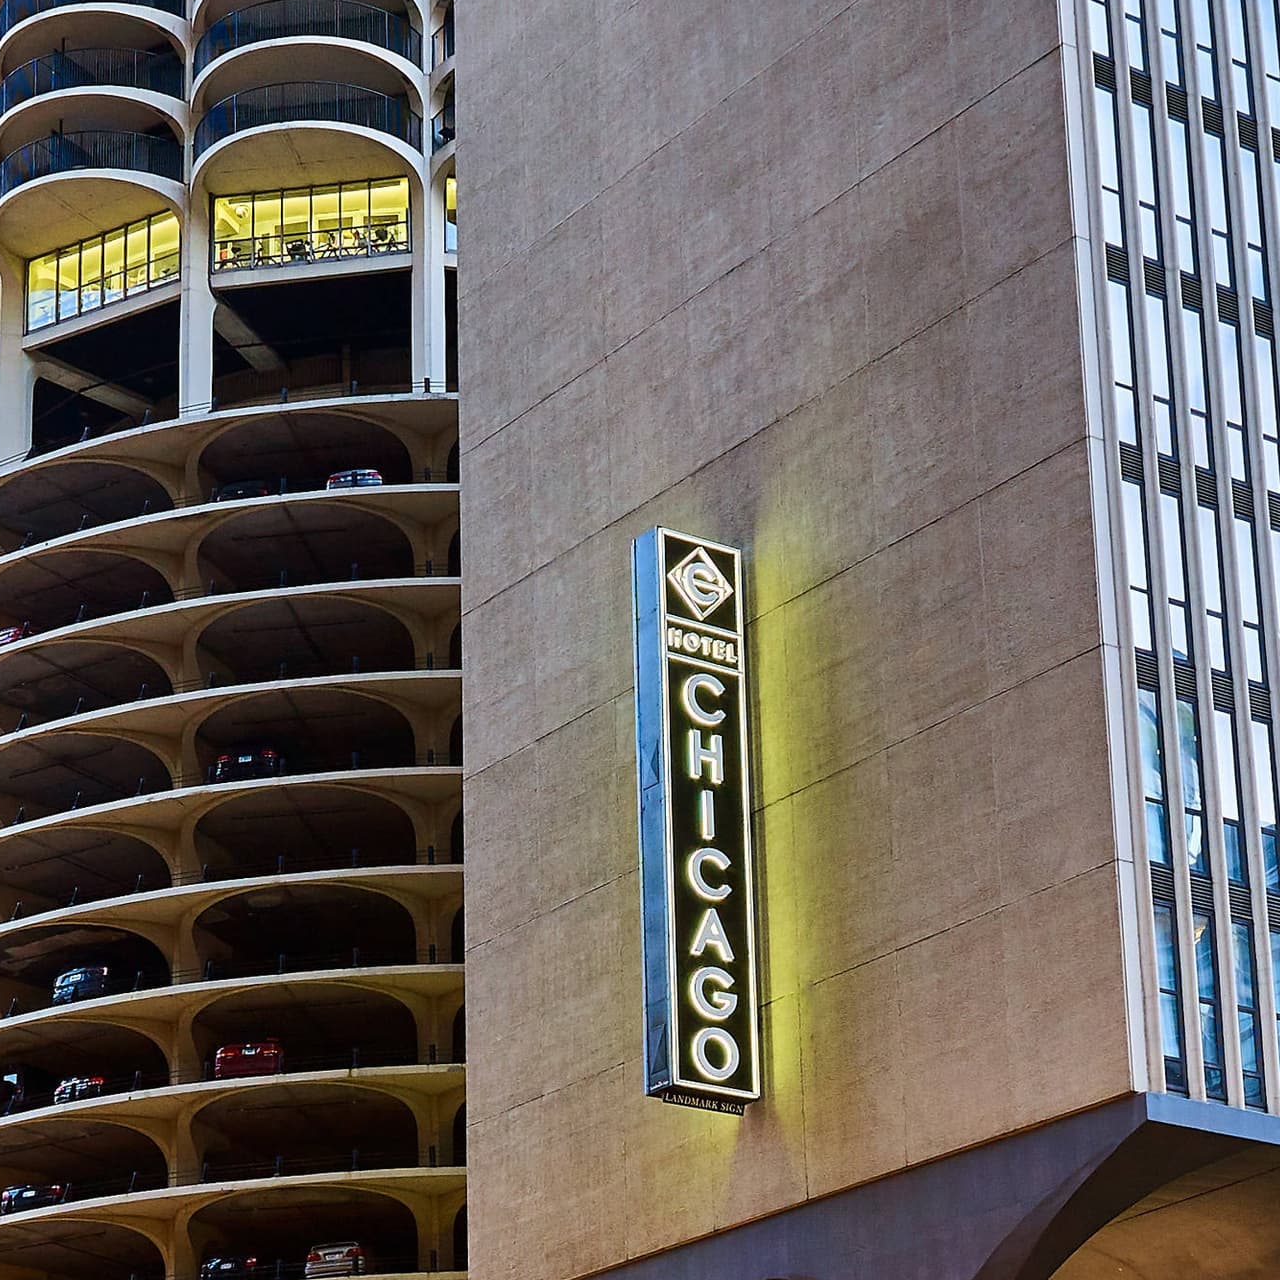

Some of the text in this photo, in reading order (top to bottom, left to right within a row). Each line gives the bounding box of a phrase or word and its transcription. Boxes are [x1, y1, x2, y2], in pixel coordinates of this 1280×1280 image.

[668, 627, 738, 663] HOTEL
[681, 672, 741, 1082] CHICAGO
[664, 1092, 744, 1114] LANDMARK SIGN
